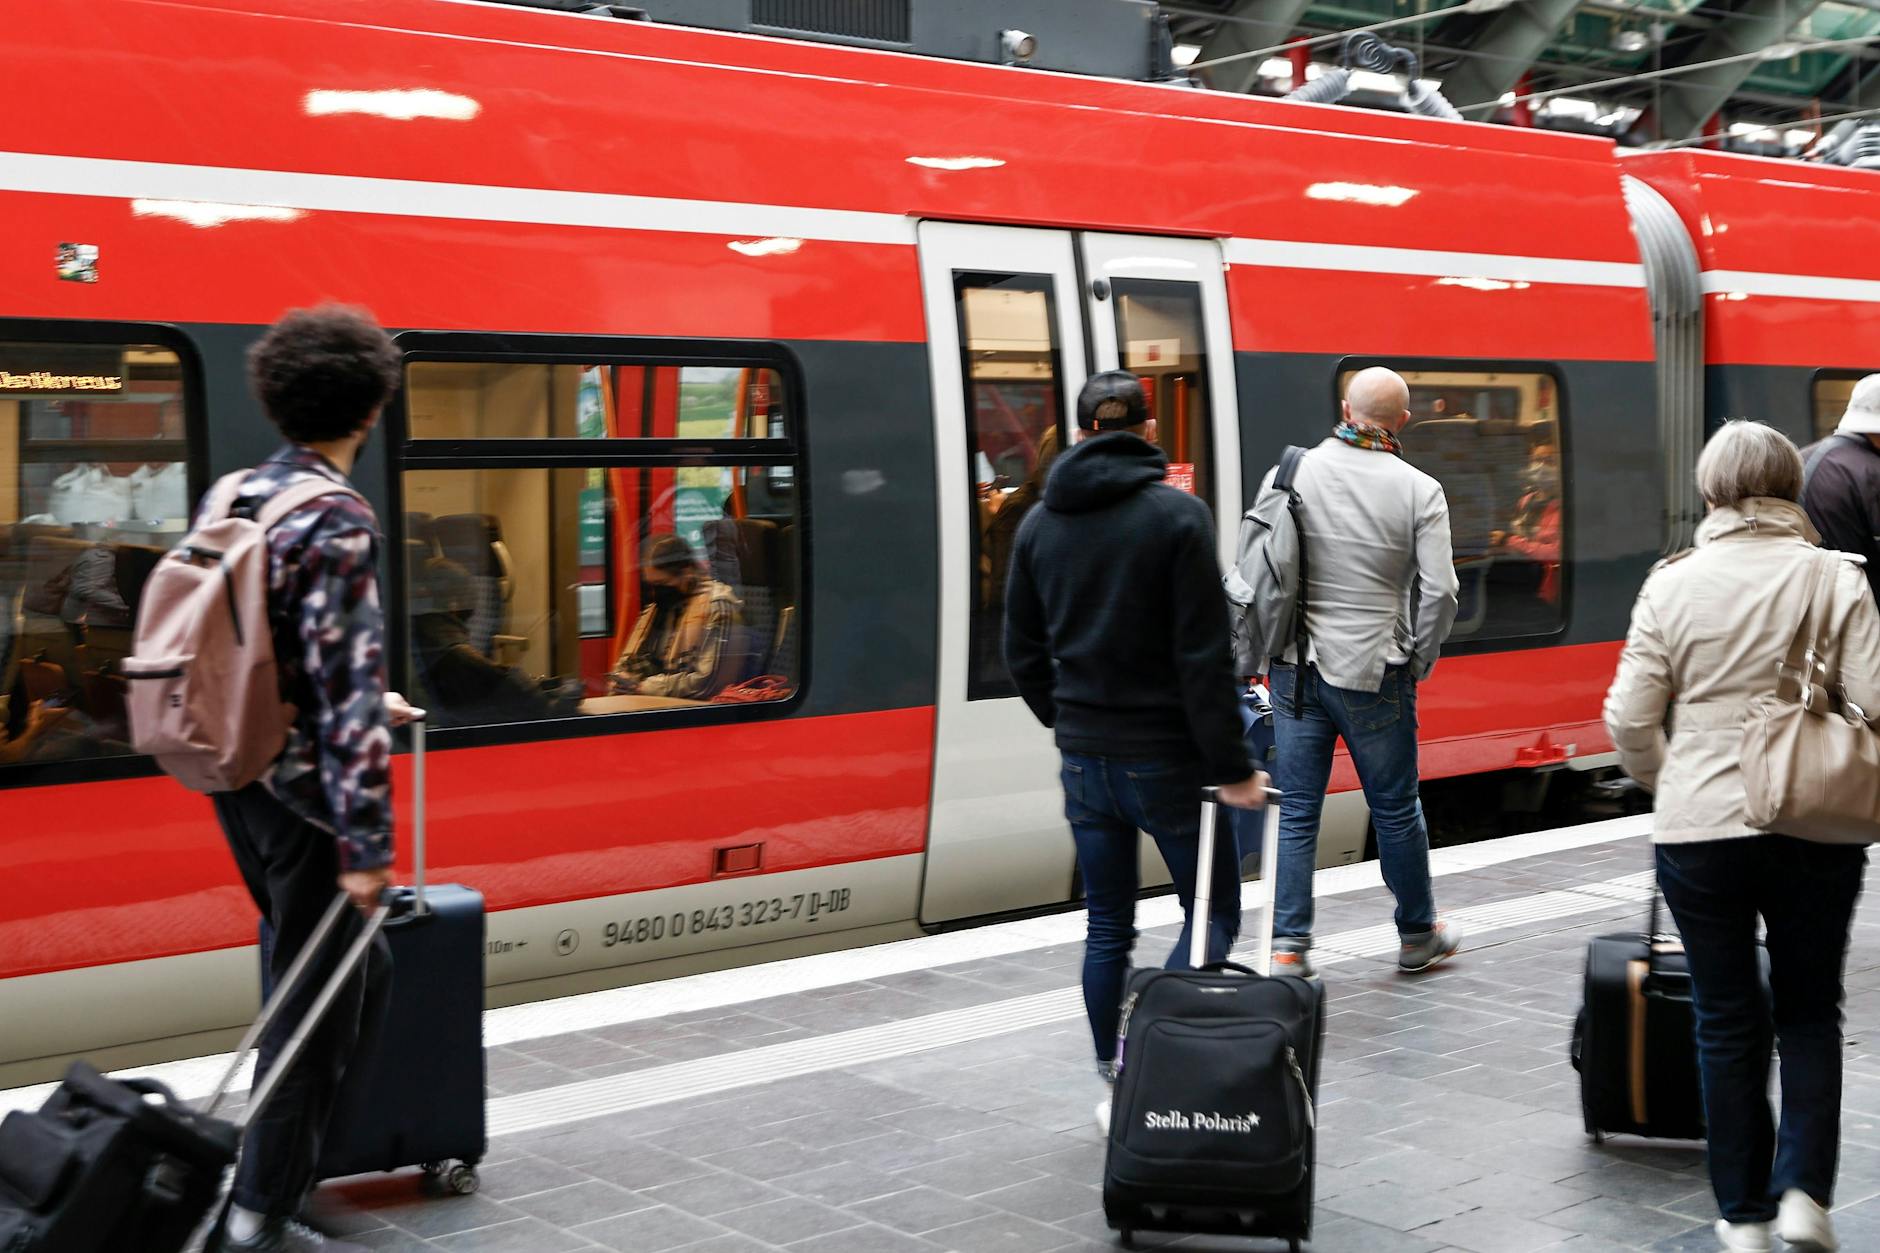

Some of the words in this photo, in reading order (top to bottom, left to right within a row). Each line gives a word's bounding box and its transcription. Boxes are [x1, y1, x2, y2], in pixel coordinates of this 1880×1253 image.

[603, 915, 665, 947] 9480
[670, 912, 686, 938] 0
[691, 904, 735, 935] 843
[739, 893, 805, 927] 323-7
[808, 887, 852, 922] D-DB
[1145, 1109, 1190, 1129] Stella
[1192, 1110, 1251, 1134] Polaris
